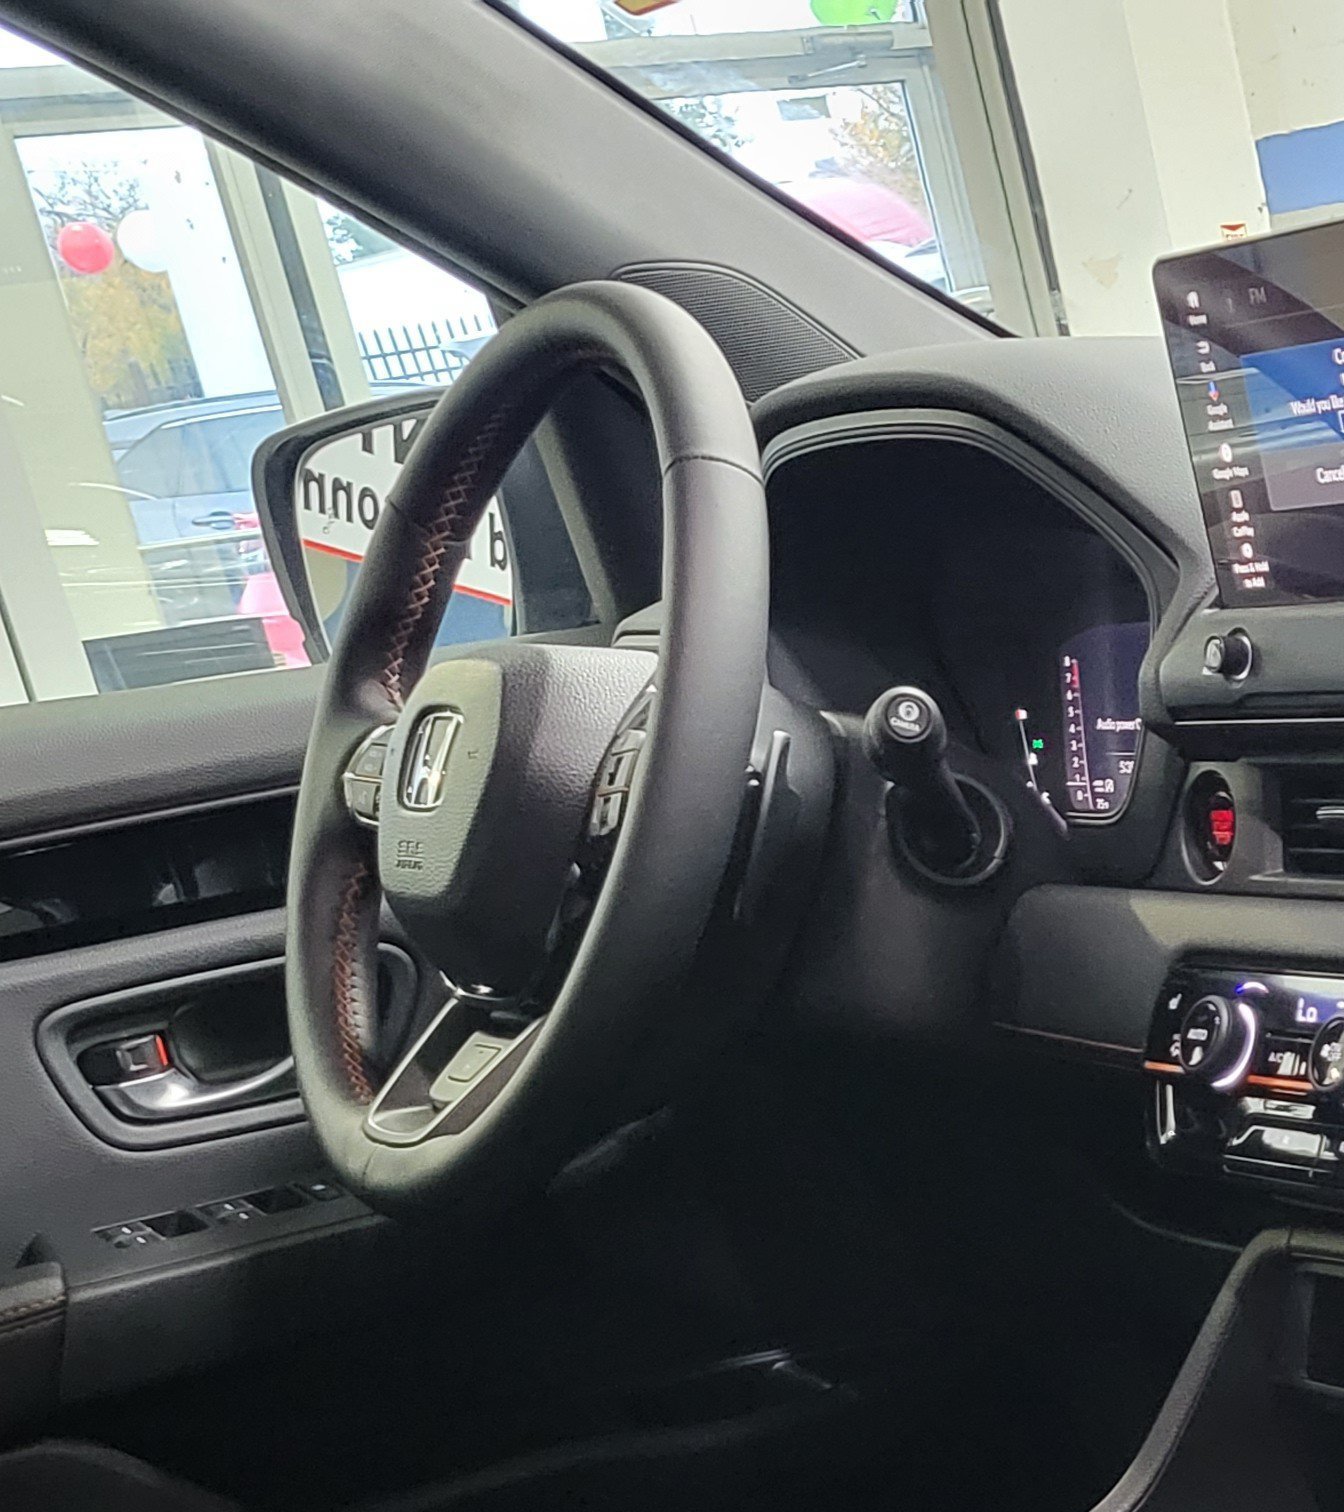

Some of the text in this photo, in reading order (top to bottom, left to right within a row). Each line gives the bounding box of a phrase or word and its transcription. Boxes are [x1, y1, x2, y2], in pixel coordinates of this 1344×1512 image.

[1290, 398, 1316, 416] Would
[1316, 398, 1331, 415] you
[1331, 394, 1344, 410] like
